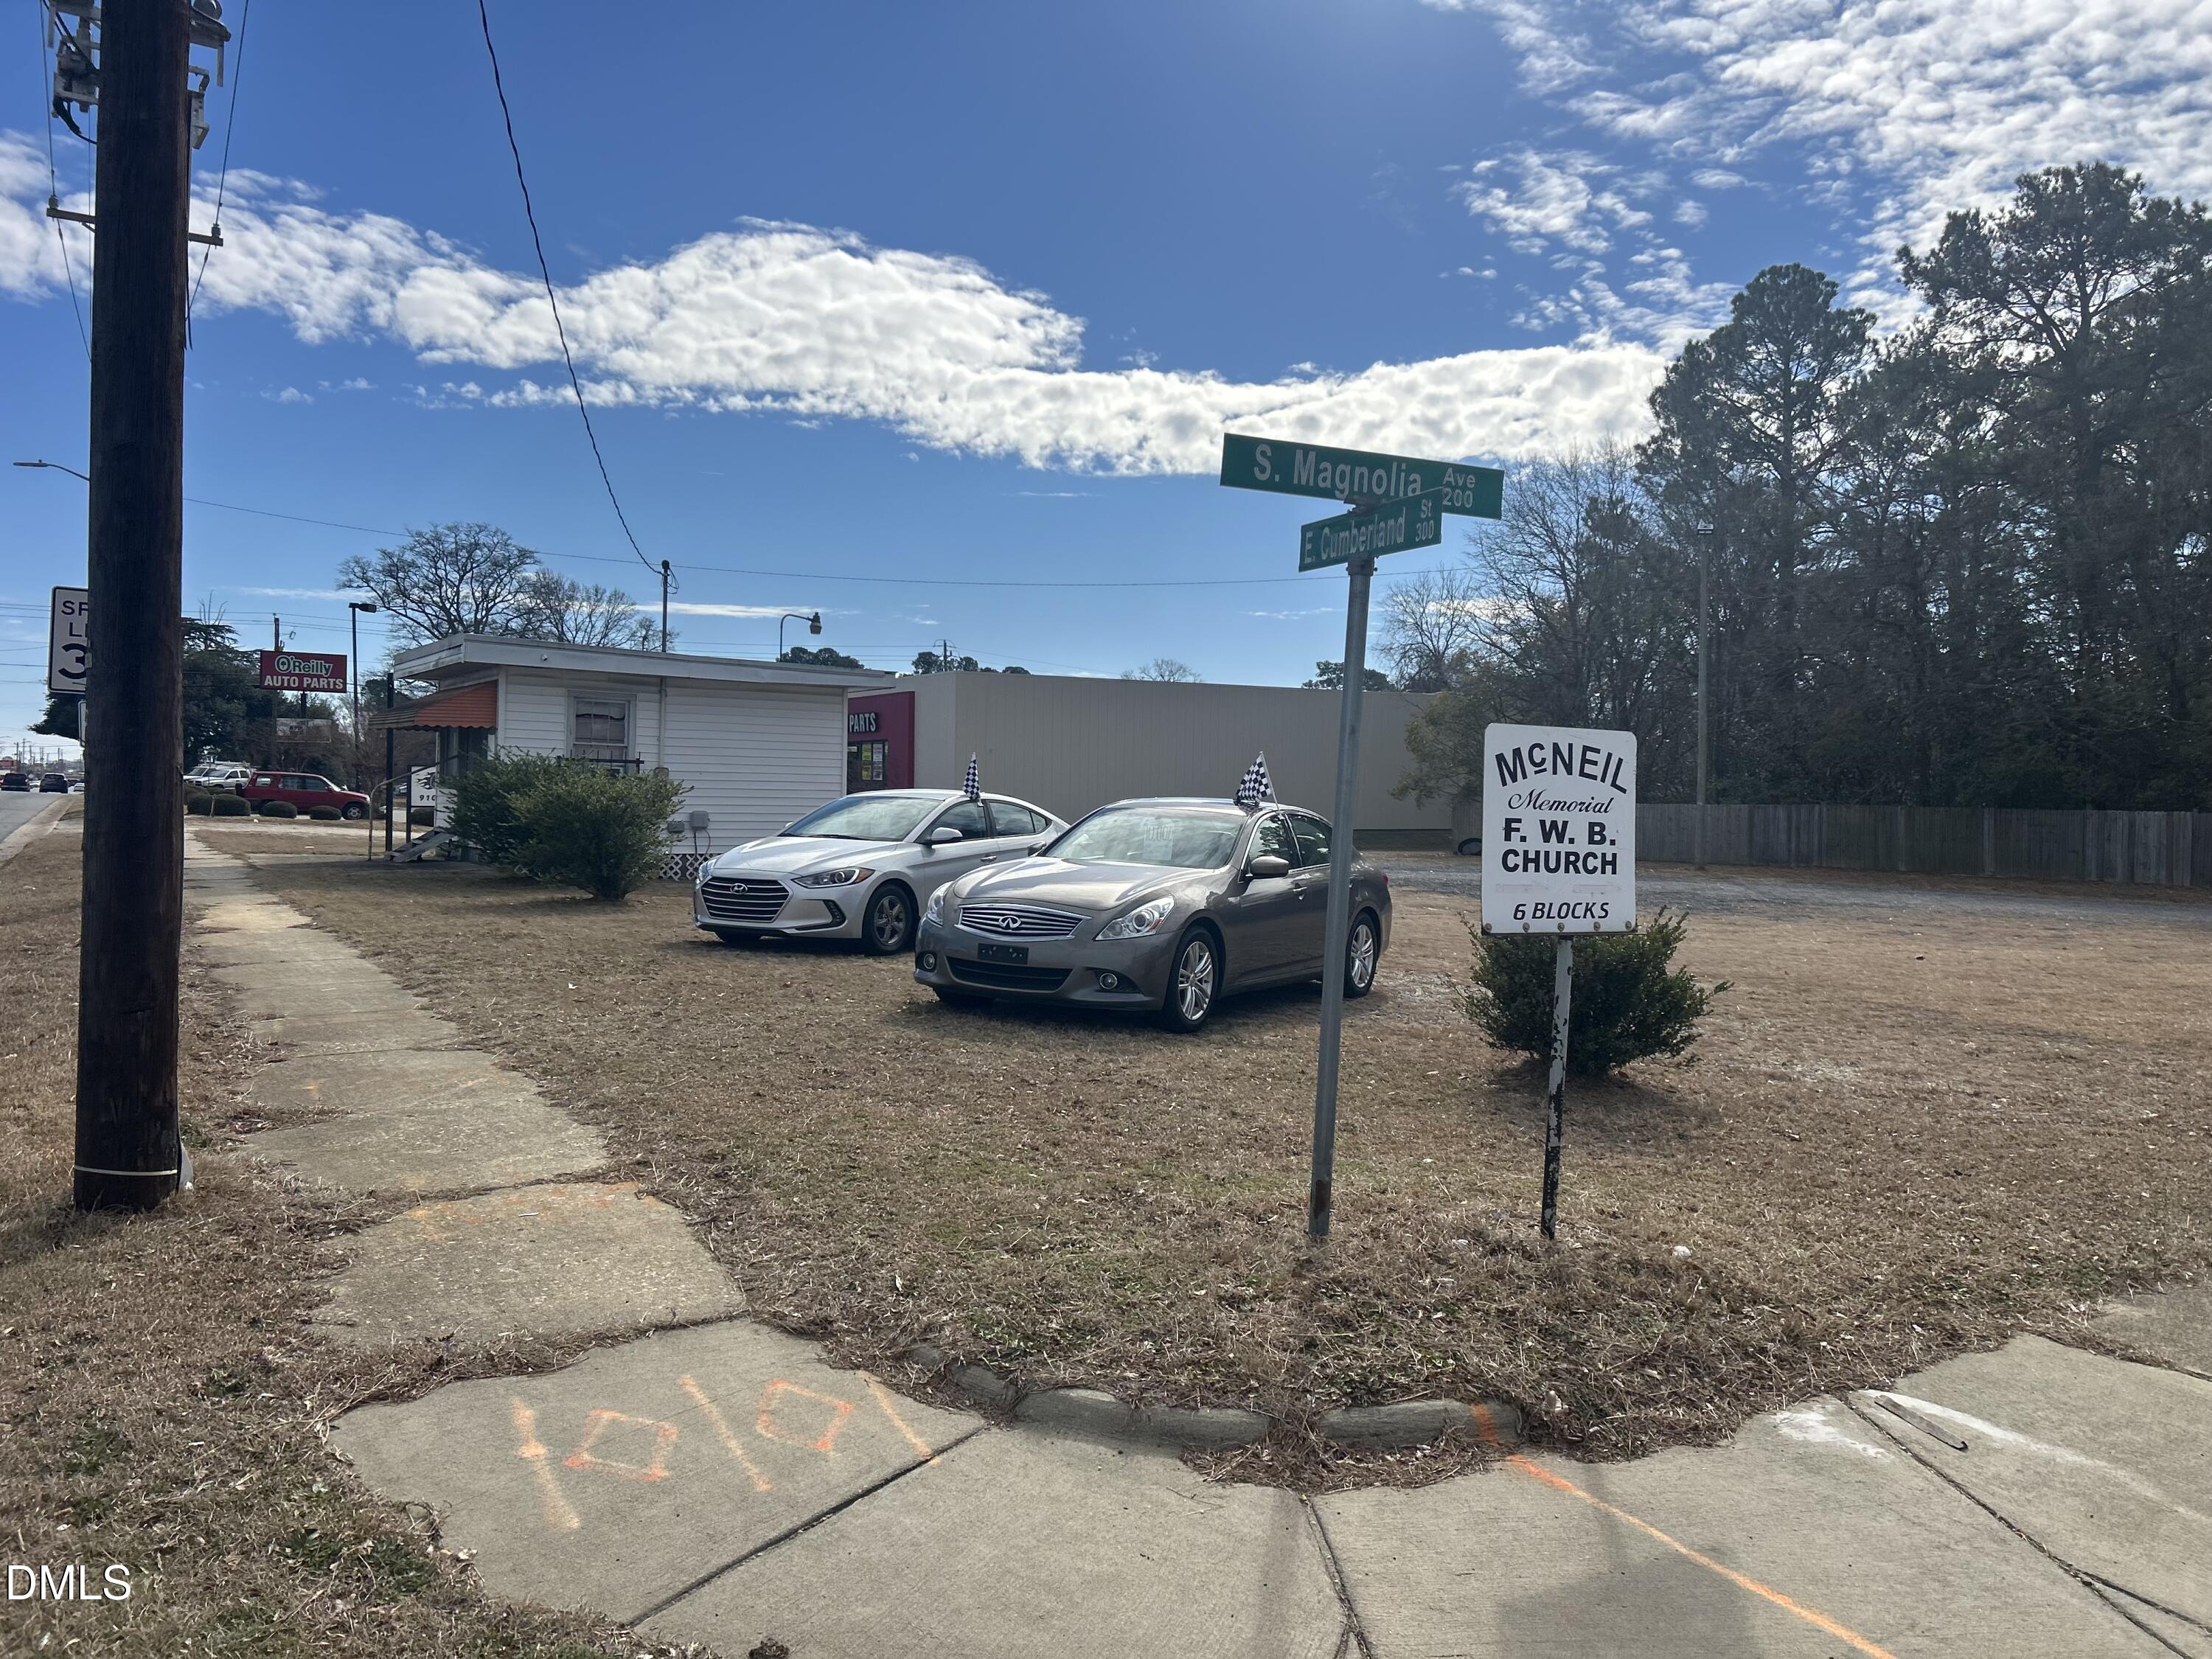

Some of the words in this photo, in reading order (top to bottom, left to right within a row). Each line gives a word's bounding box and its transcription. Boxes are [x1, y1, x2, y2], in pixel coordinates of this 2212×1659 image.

[1253, 443, 1281, 482] S.
[1293, 448, 1422, 501] Magnolia
[1442, 467, 1476, 488] Ave
[1420, 498, 1433, 519] St
[1442, 487, 1474, 509] 200
[1304, 531, 1315, 564] E.
[1321, 507, 1406, 560] Cumberland
[1415, 519, 1435, 543] 300
[58, 643, 87, 680] 3
[275, 655, 333, 677] O'Reilly
[264, 675, 299, 688] AUTO
[303, 677, 344, 689] PARTS
[849, 712, 877, 732] PARTS
[1508, 788, 1615, 814] Memorial
[1503, 817, 1527, 843] F.
[1539, 819, 1575, 845] W.
[1587, 821, 1616, 846] B.
[1501, 849, 1618, 875] CHURCH
[1513, 903, 1527, 921] 6
[1531, 902, 1610, 920] BLOCKS
